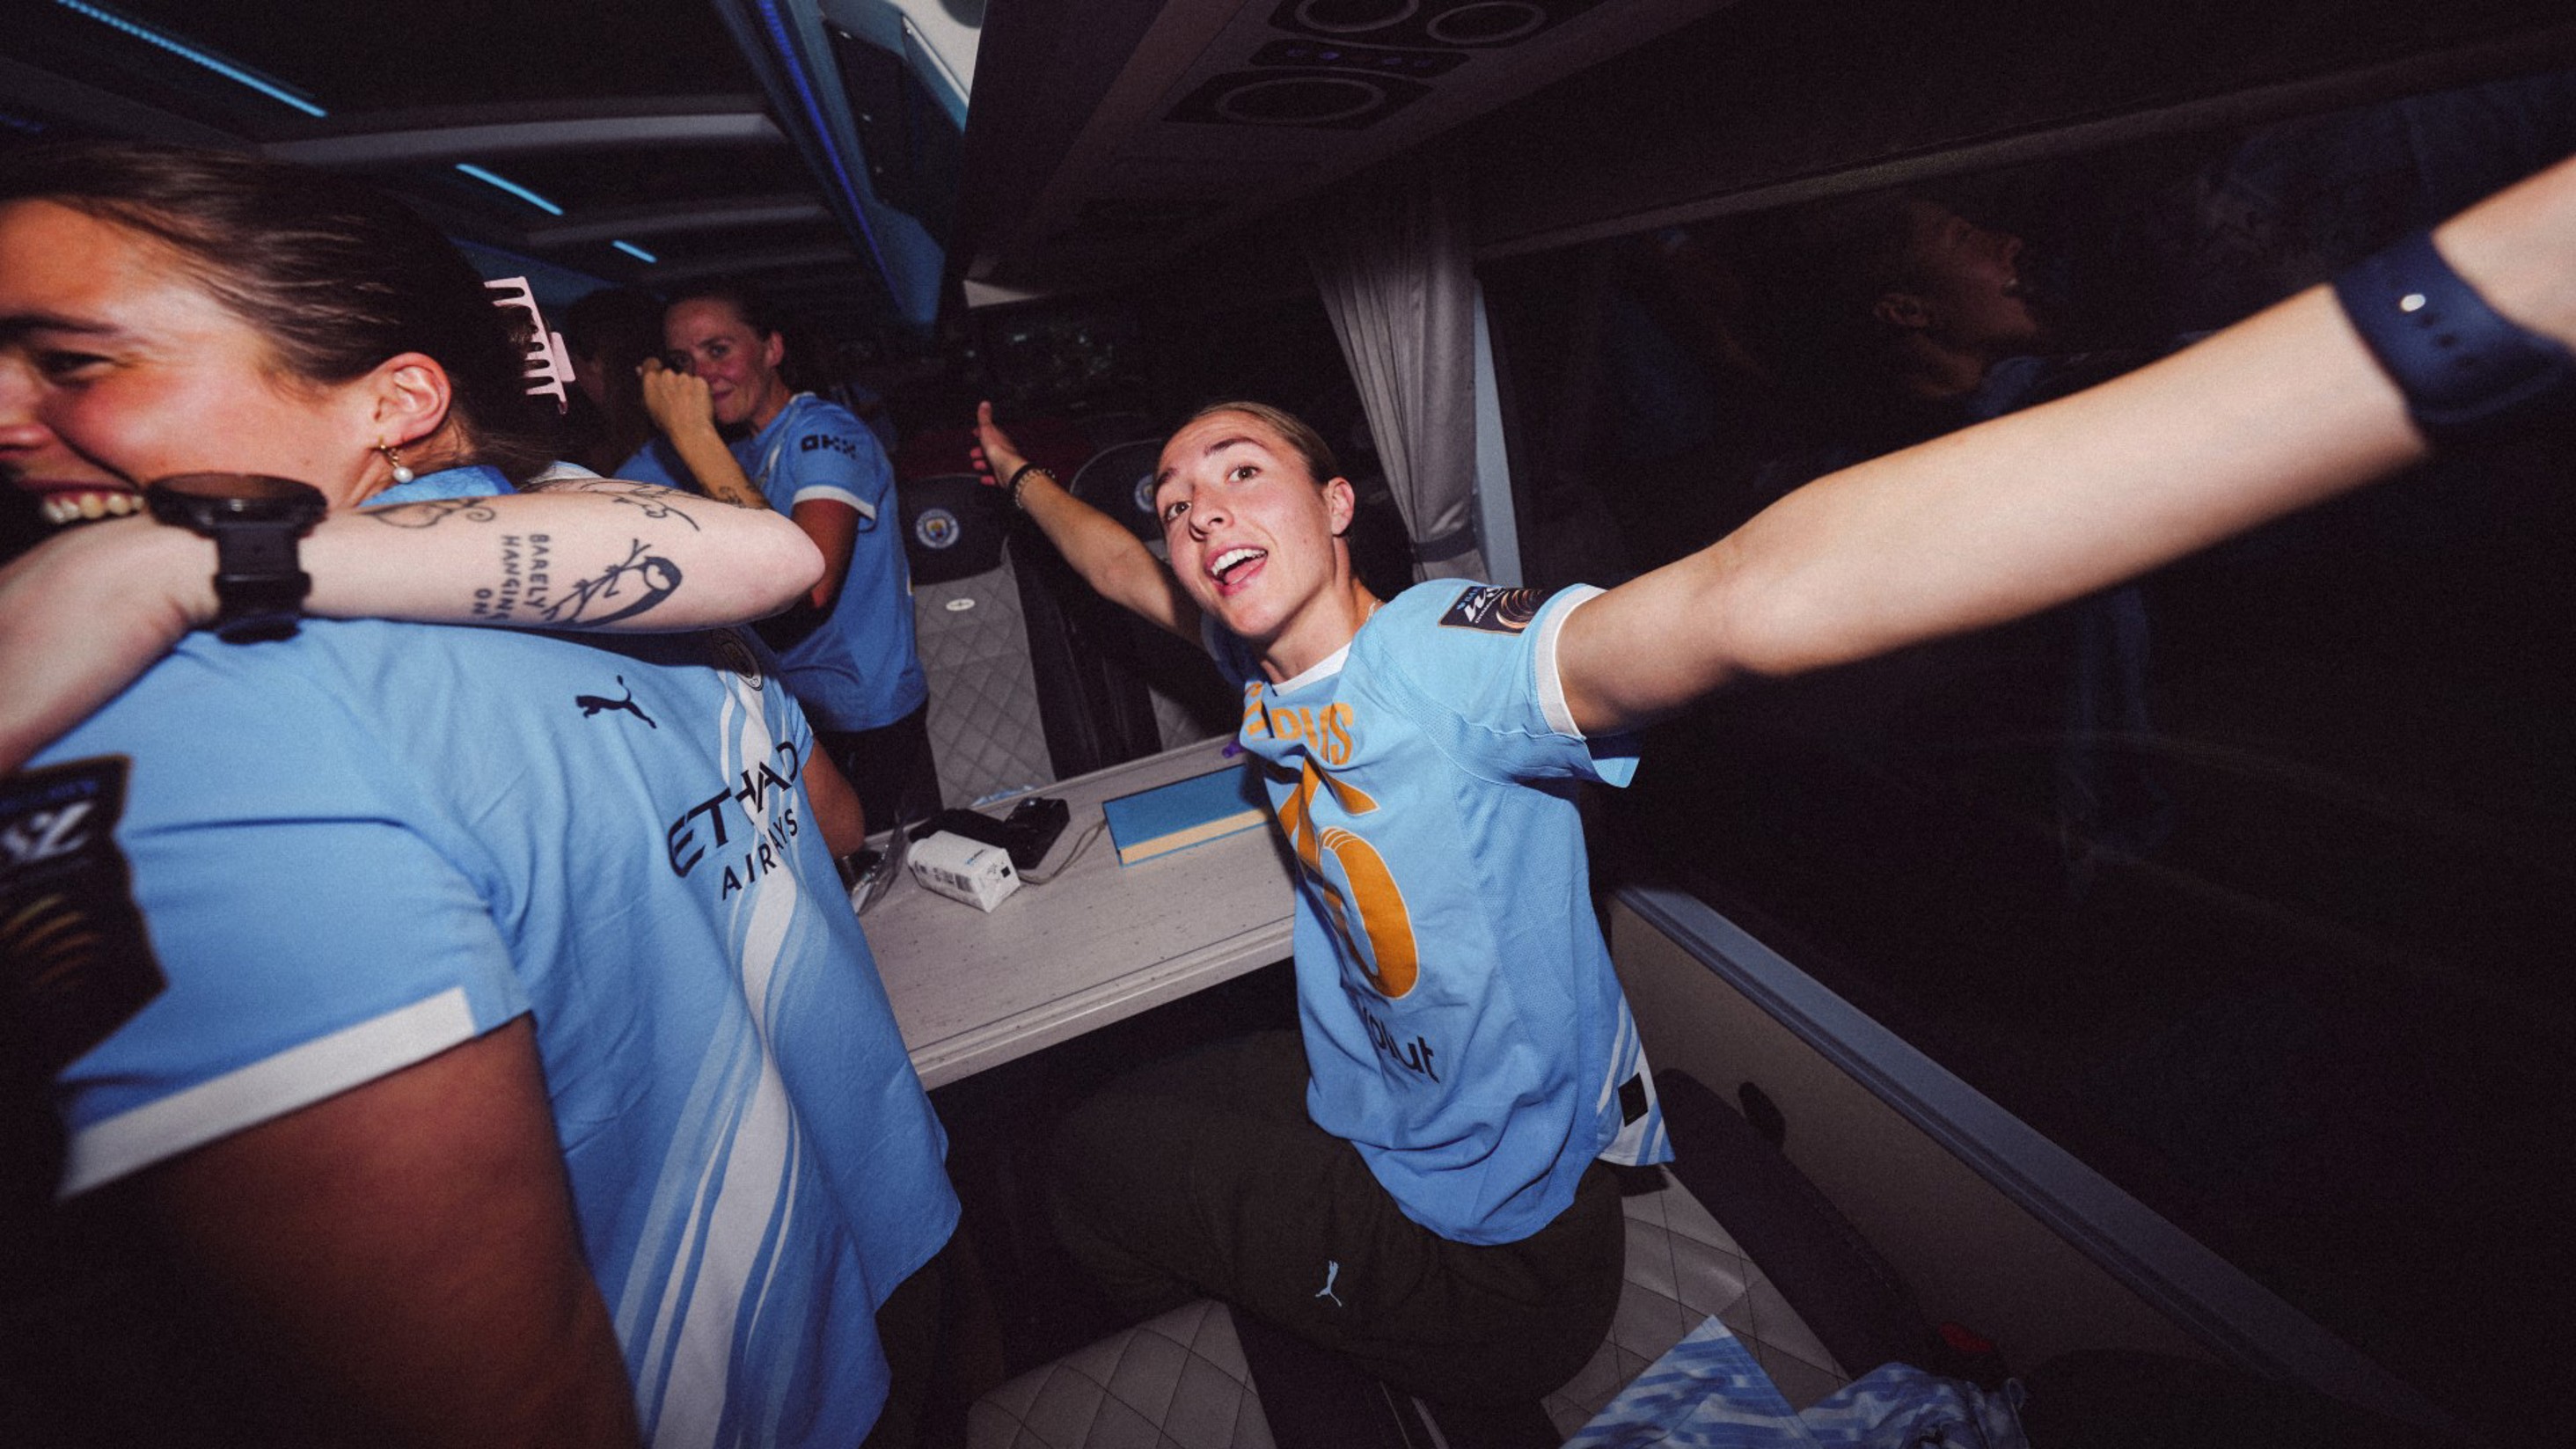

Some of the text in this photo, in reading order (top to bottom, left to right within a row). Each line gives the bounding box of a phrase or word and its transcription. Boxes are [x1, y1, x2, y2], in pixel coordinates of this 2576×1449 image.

[801, 435, 857, 459] OKX
[472, 588, 493, 615] ON
[523, 534, 550, 609] BARELY
[668, 741, 799, 878] ETHAD
[721, 809, 799, 901] AIRAYS
